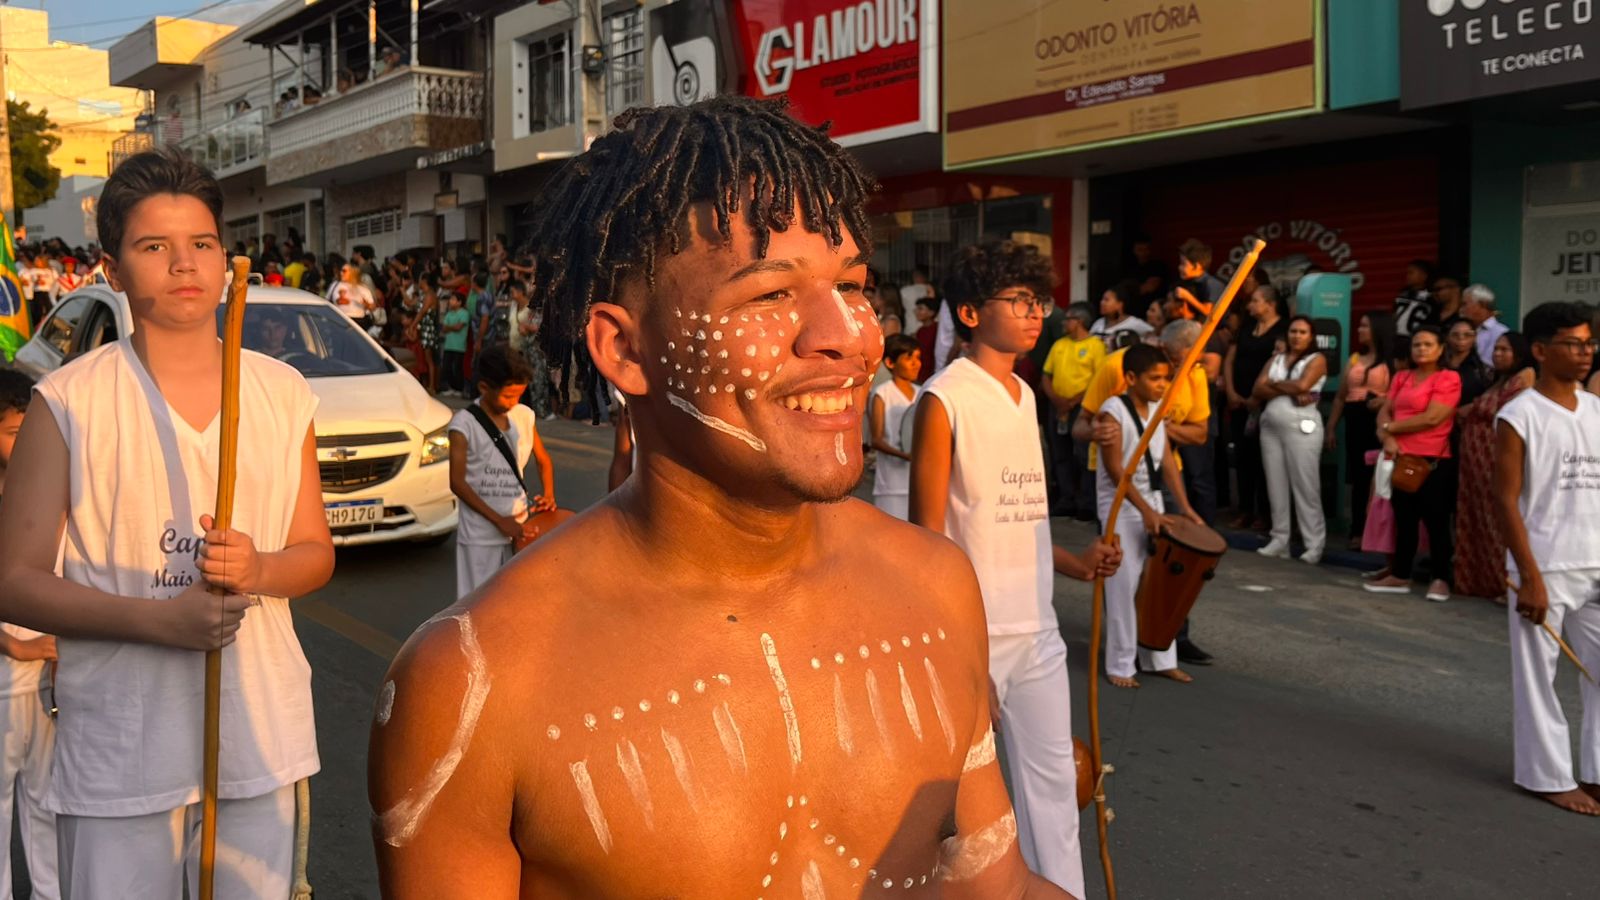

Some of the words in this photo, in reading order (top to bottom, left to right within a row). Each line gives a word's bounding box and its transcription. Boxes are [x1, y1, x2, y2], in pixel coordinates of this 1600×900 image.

[1035, 21, 1117, 60] ODONTO
[1123, 2, 1201, 39] VITÓRIA
[1442, 0, 1592, 49] TELECO
[754, 0, 918, 96] GLAMOUR
[1080, 42, 1148, 64] DENTISTA
[1481, 58, 1500, 75] TE
[1502, 43, 1584, 72] CONECTA
[150, 569, 193, 588] Mais
